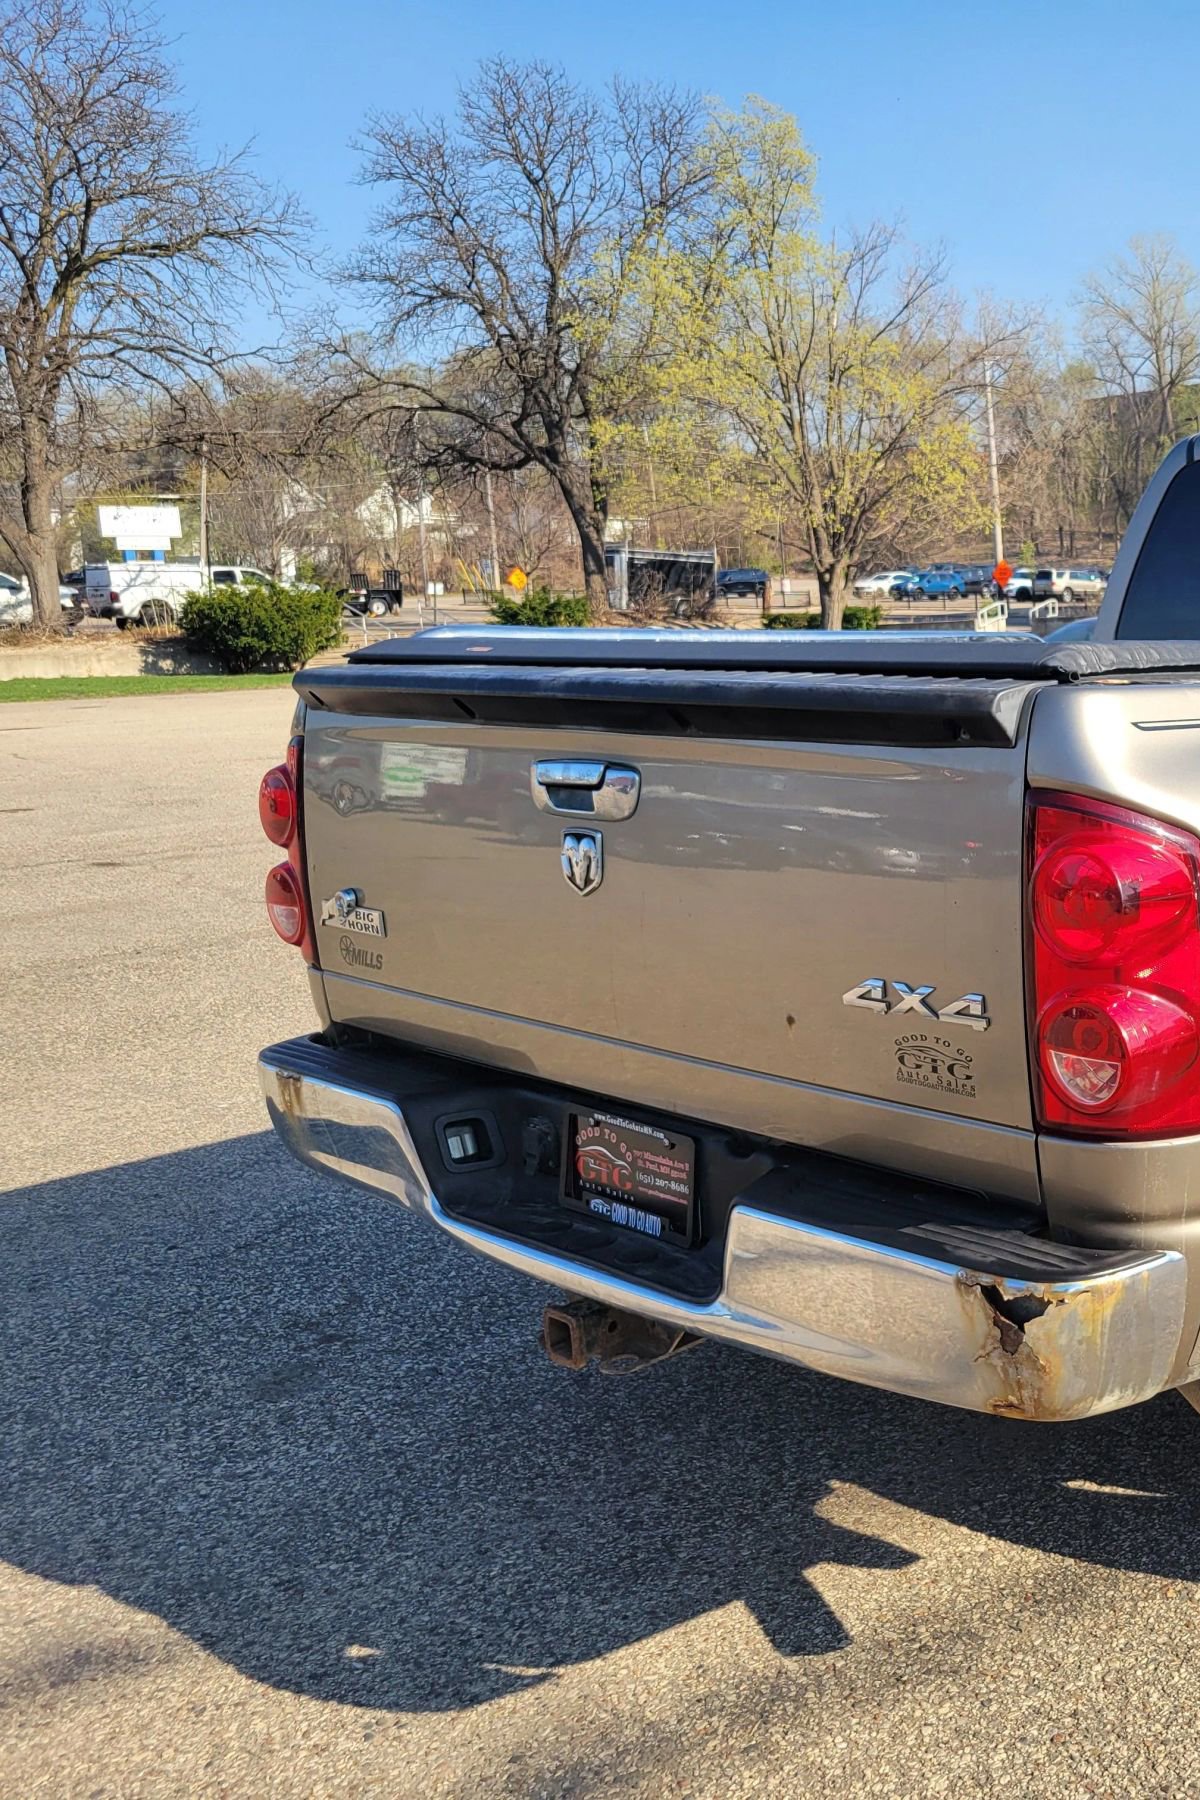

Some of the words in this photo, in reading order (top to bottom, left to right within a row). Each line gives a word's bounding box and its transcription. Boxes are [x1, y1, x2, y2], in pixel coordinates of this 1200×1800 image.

[348, 919, 380, 934] HORN
[355, 910, 374, 923] BIG
[351, 947, 384, 970] MILLS
[894, 1033, 928, 1046] GOOD
[933, 1036, 951, 1048] TO
[956, 1048, 973, 1063] GO
[896, 1066, 929, 1082] Auto
[936, 1075, 976, 1092] Sales
[575, 1126, 600, 1145] GOOD
[604, 1128, 617, 1143] TO
[620, 1142, 633, 1162] GO
[579, 1179, 602, 1191] Auto
[606, 1188, 635, 1202] Sales
[636, 1170, 654, 1185] (651)
[655, 1177, 690, 1195] 207-8686
[611, 1202, 628, 1225] GOOD
[628, 1207, 636, 1228] TO
[636, 1211, 646, 1231] GO
[645, 1213, 662, 1237] AUTO
